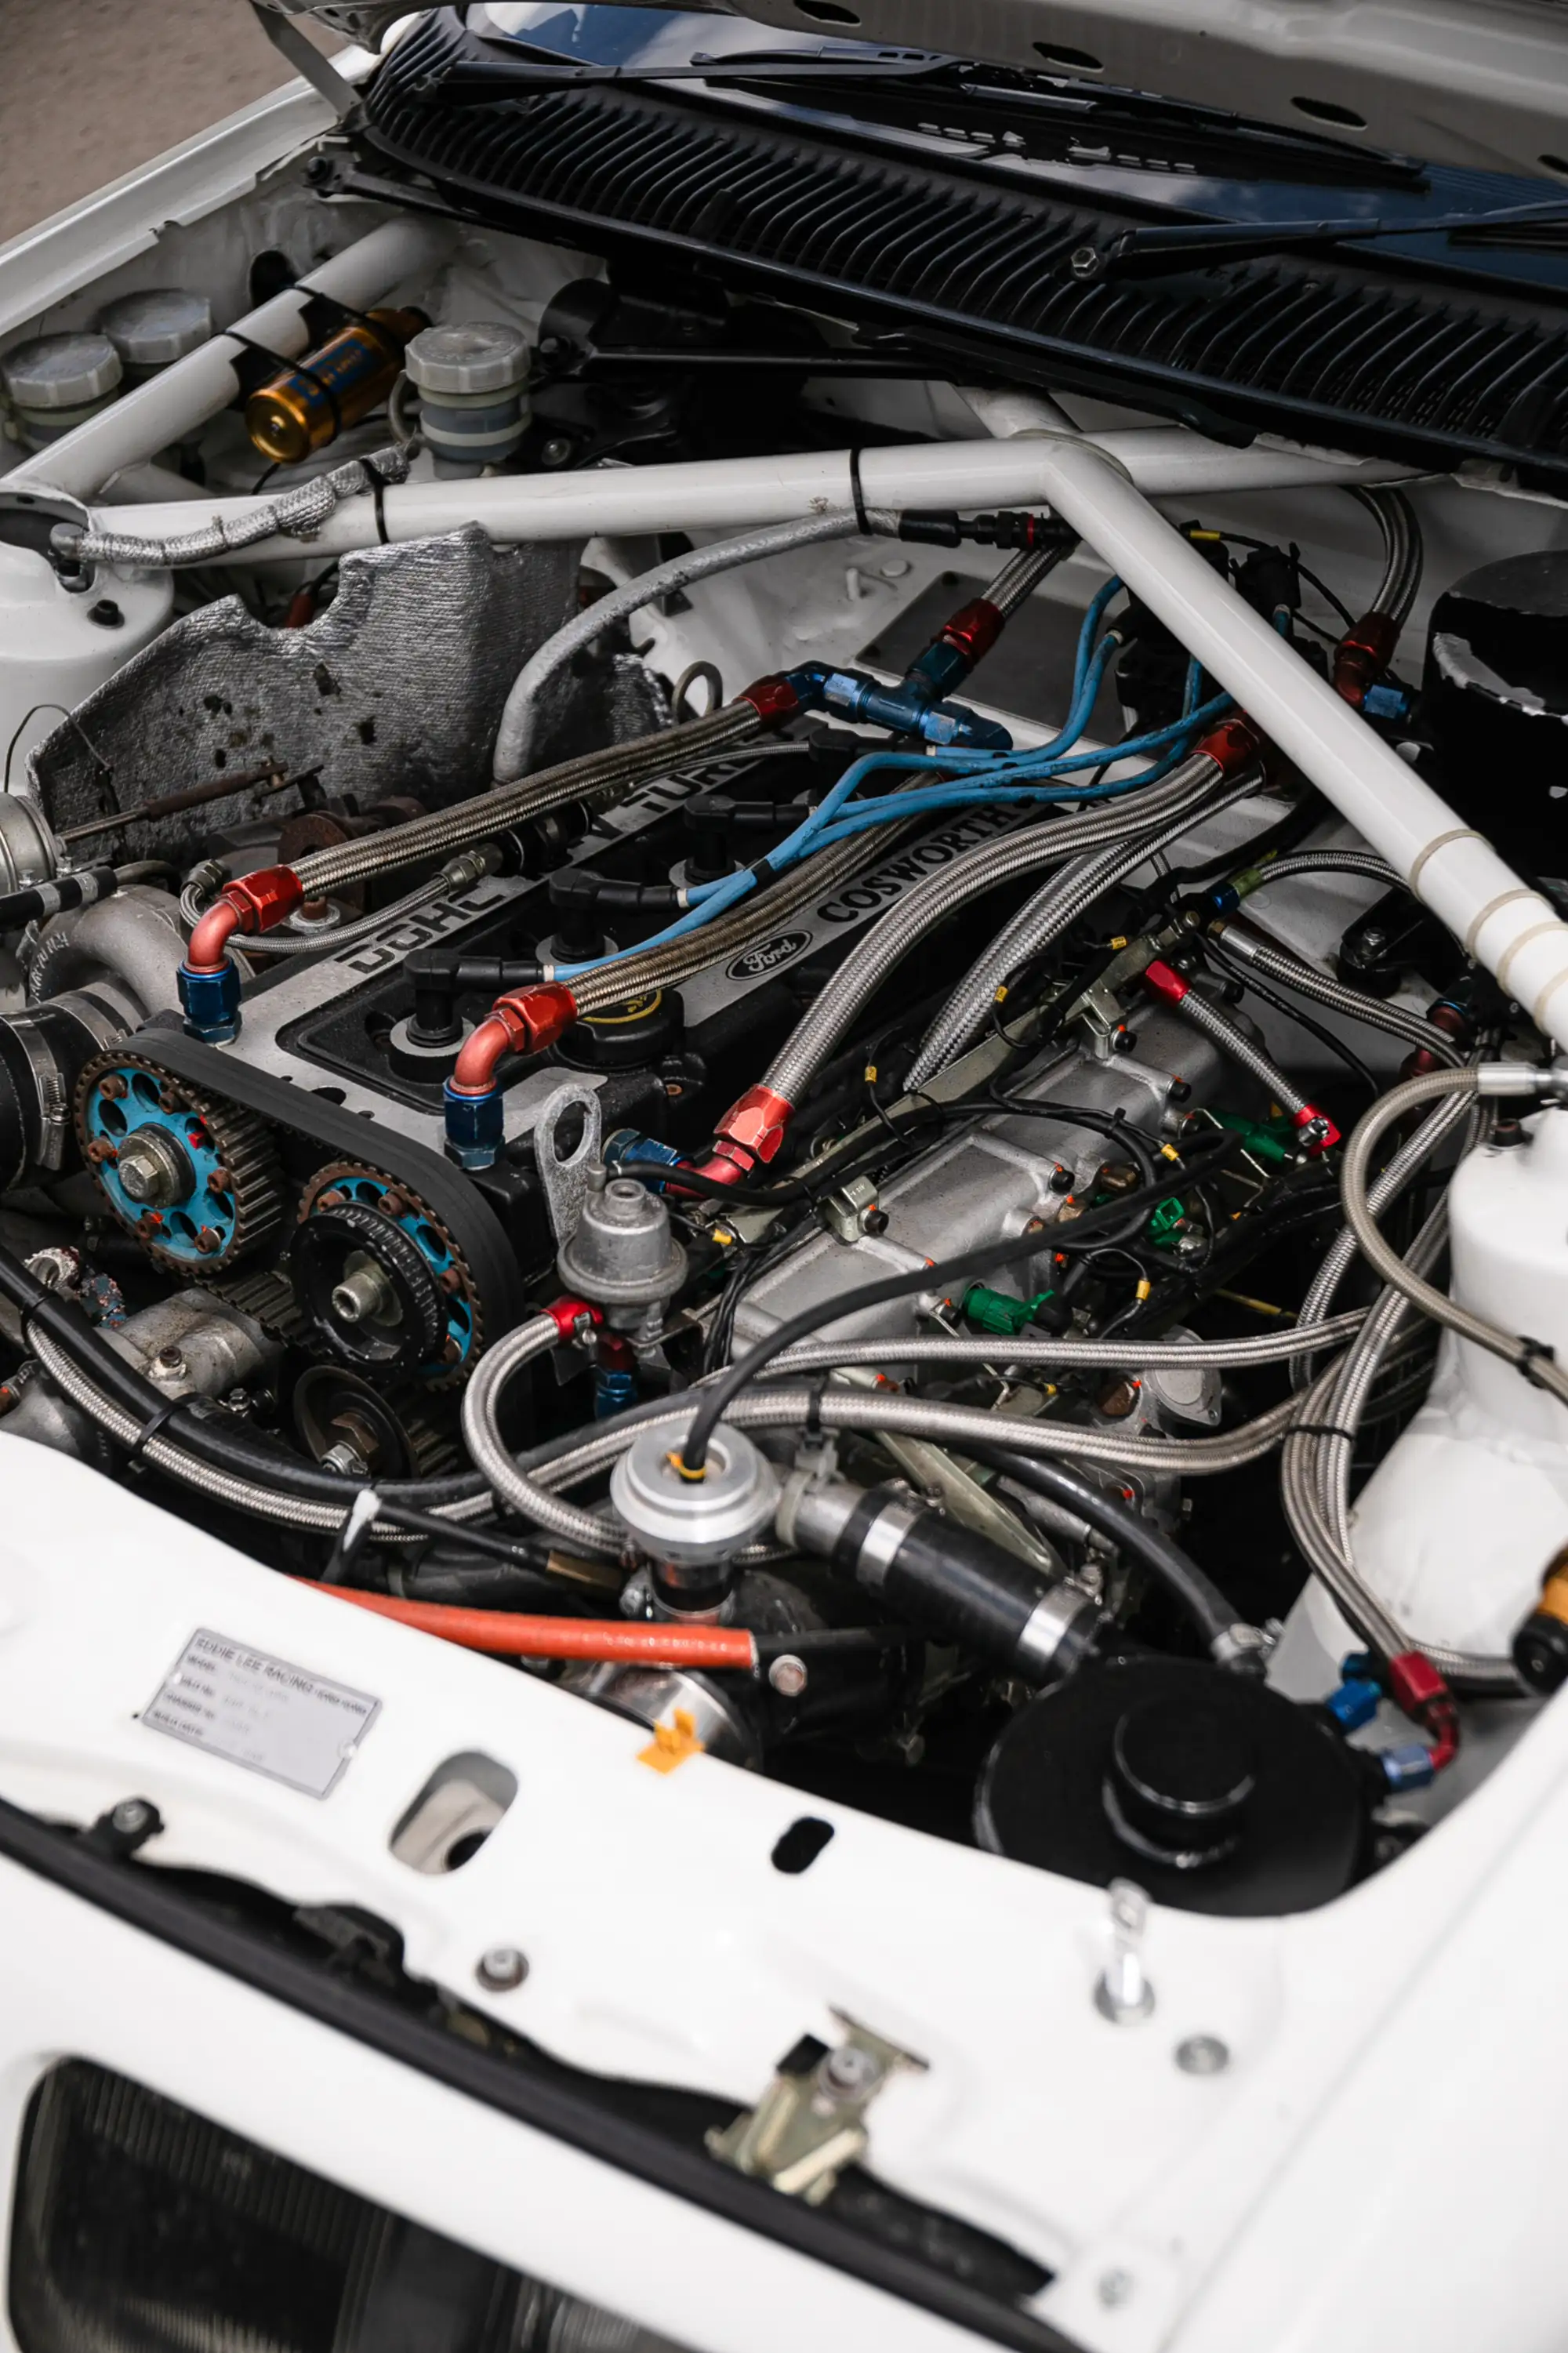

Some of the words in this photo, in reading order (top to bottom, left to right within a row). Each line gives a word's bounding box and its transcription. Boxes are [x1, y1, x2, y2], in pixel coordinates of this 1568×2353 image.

[817, 804, 1020, 923] COSWORTH
[334, 882, 506, 974] DOHC
[744, 939, 797, 971] Ford
[264, 1666, 314, 1692] RACING
